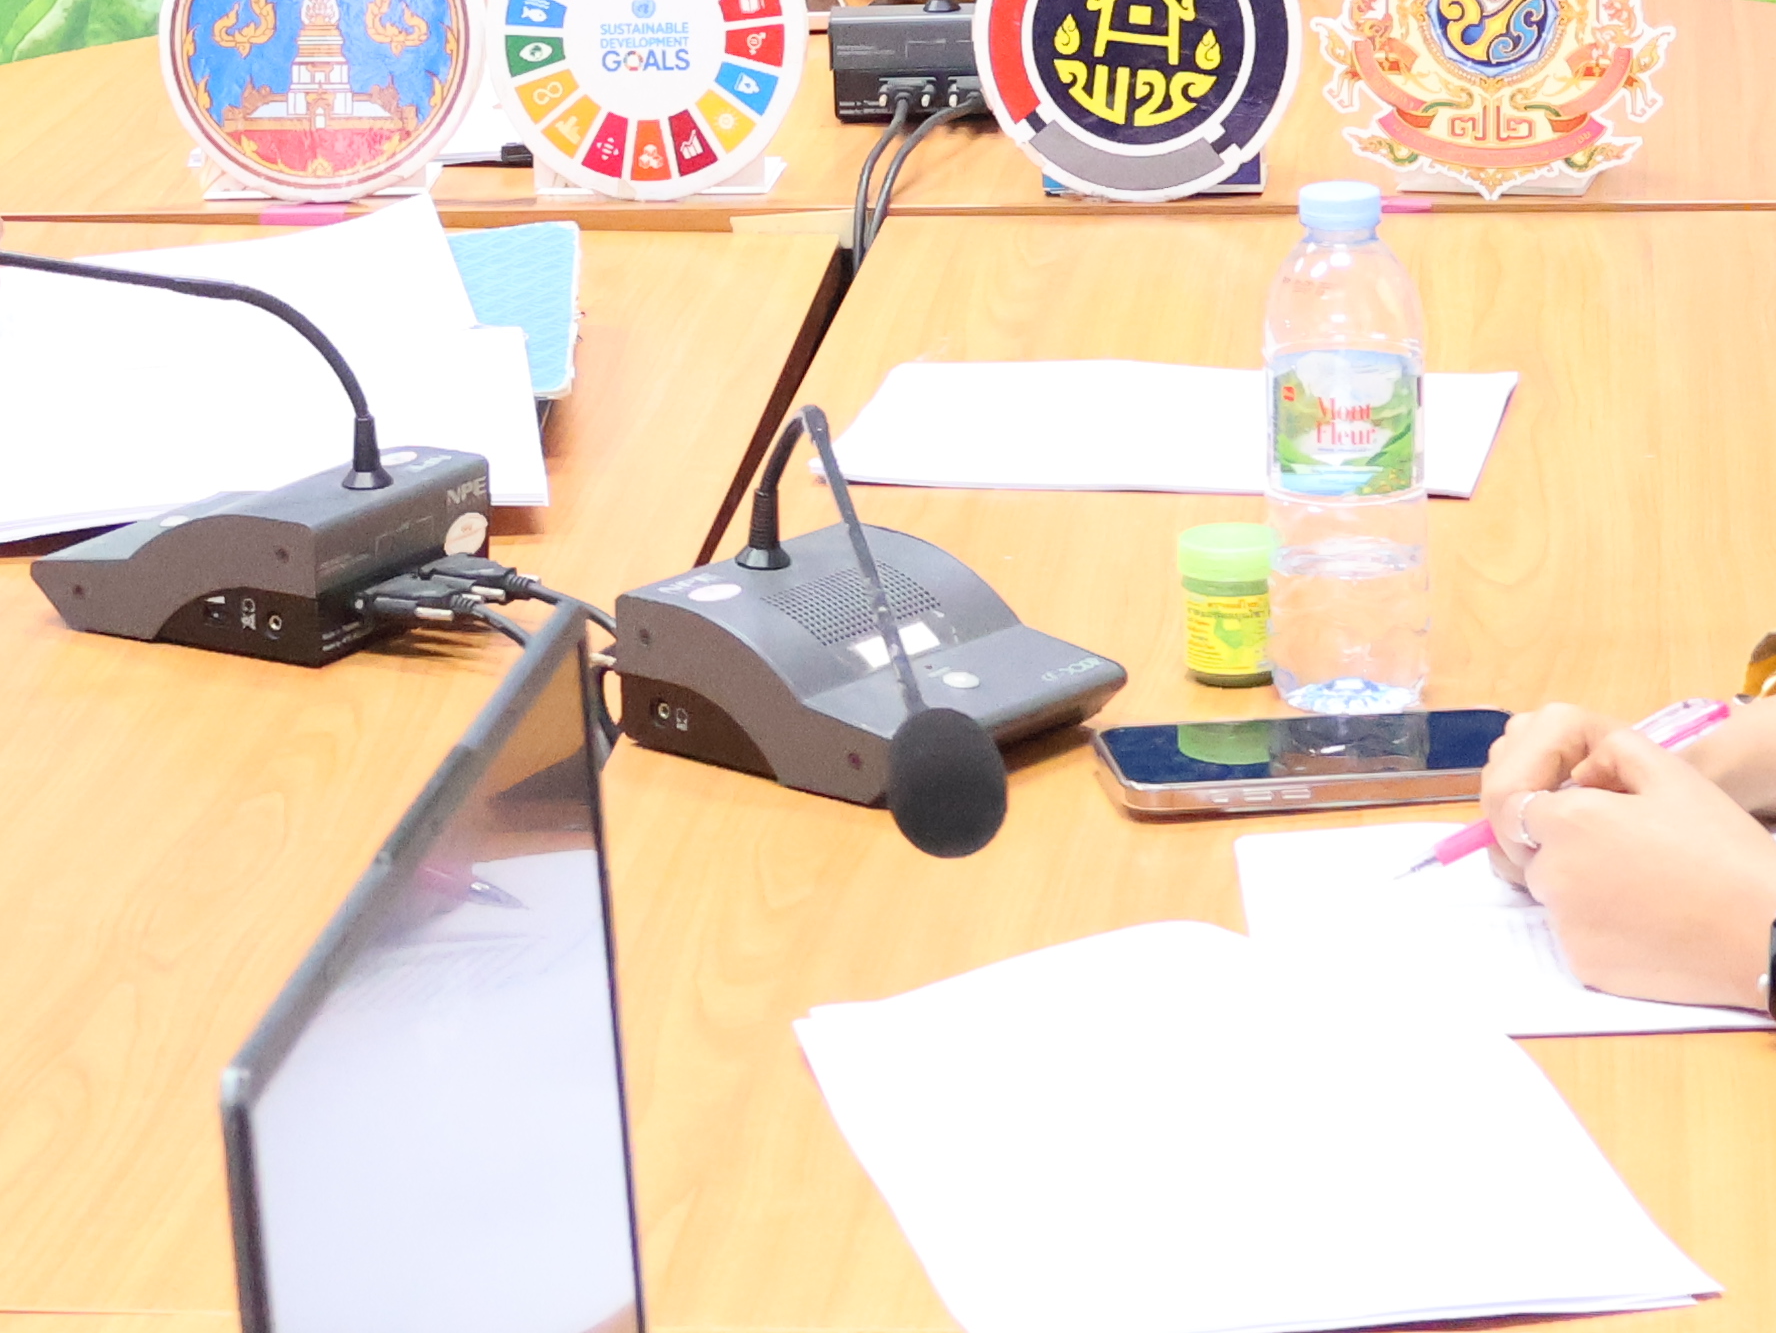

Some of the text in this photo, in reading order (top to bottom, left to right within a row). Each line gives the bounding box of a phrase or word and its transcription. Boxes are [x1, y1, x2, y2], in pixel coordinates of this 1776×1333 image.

[599, 21, 689, 34] SUSTAINABLE
[599, 36, 690, 49] DEVELOPMENT
[601, 49, 691, 72] GOALS
[1315, 420, 1377, 446] Fleur
[446, 476, 487, 506] NPE
